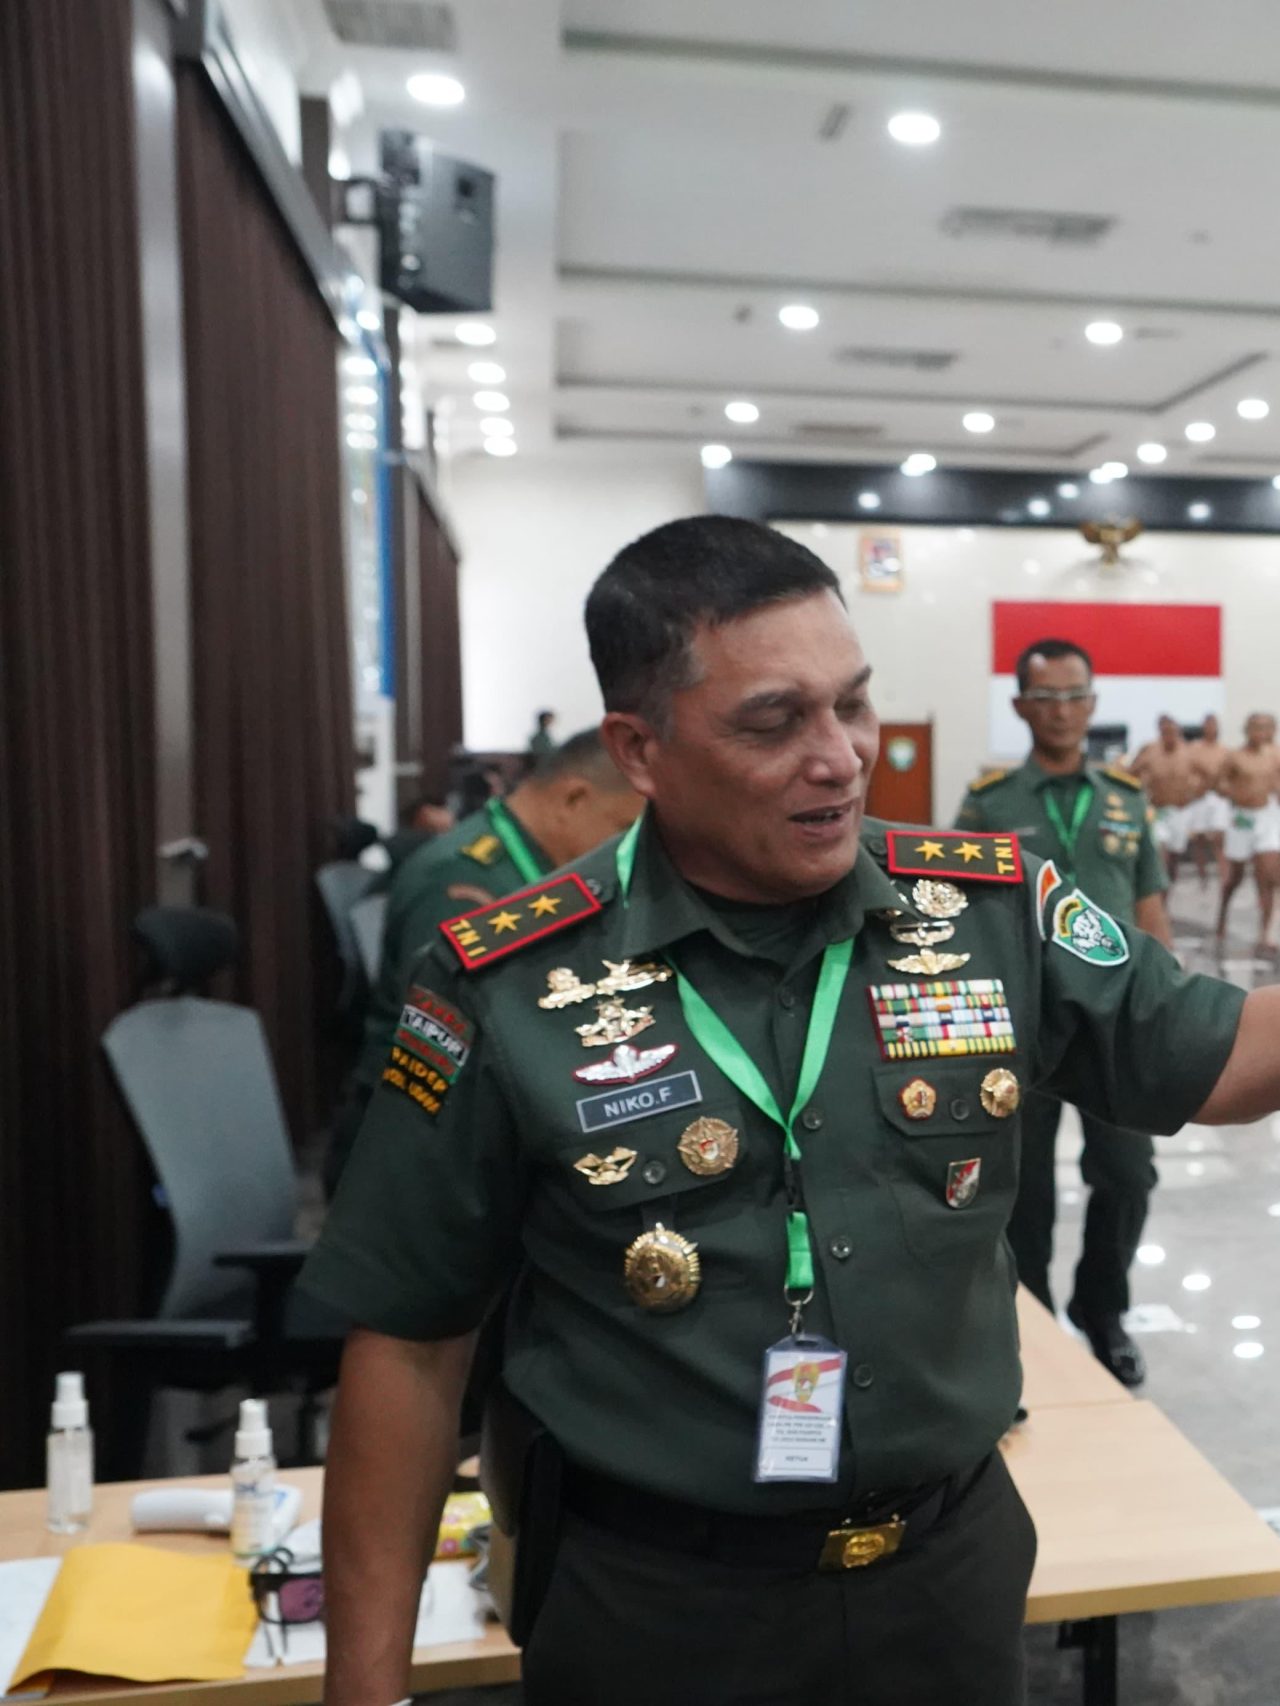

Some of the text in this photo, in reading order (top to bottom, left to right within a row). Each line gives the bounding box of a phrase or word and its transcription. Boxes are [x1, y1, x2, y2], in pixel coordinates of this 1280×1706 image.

[994, 837, 1016, 874] TNI
[449, 918, 488, 958] TNI
[604, 1086, 672, 1117] NIKO.F
